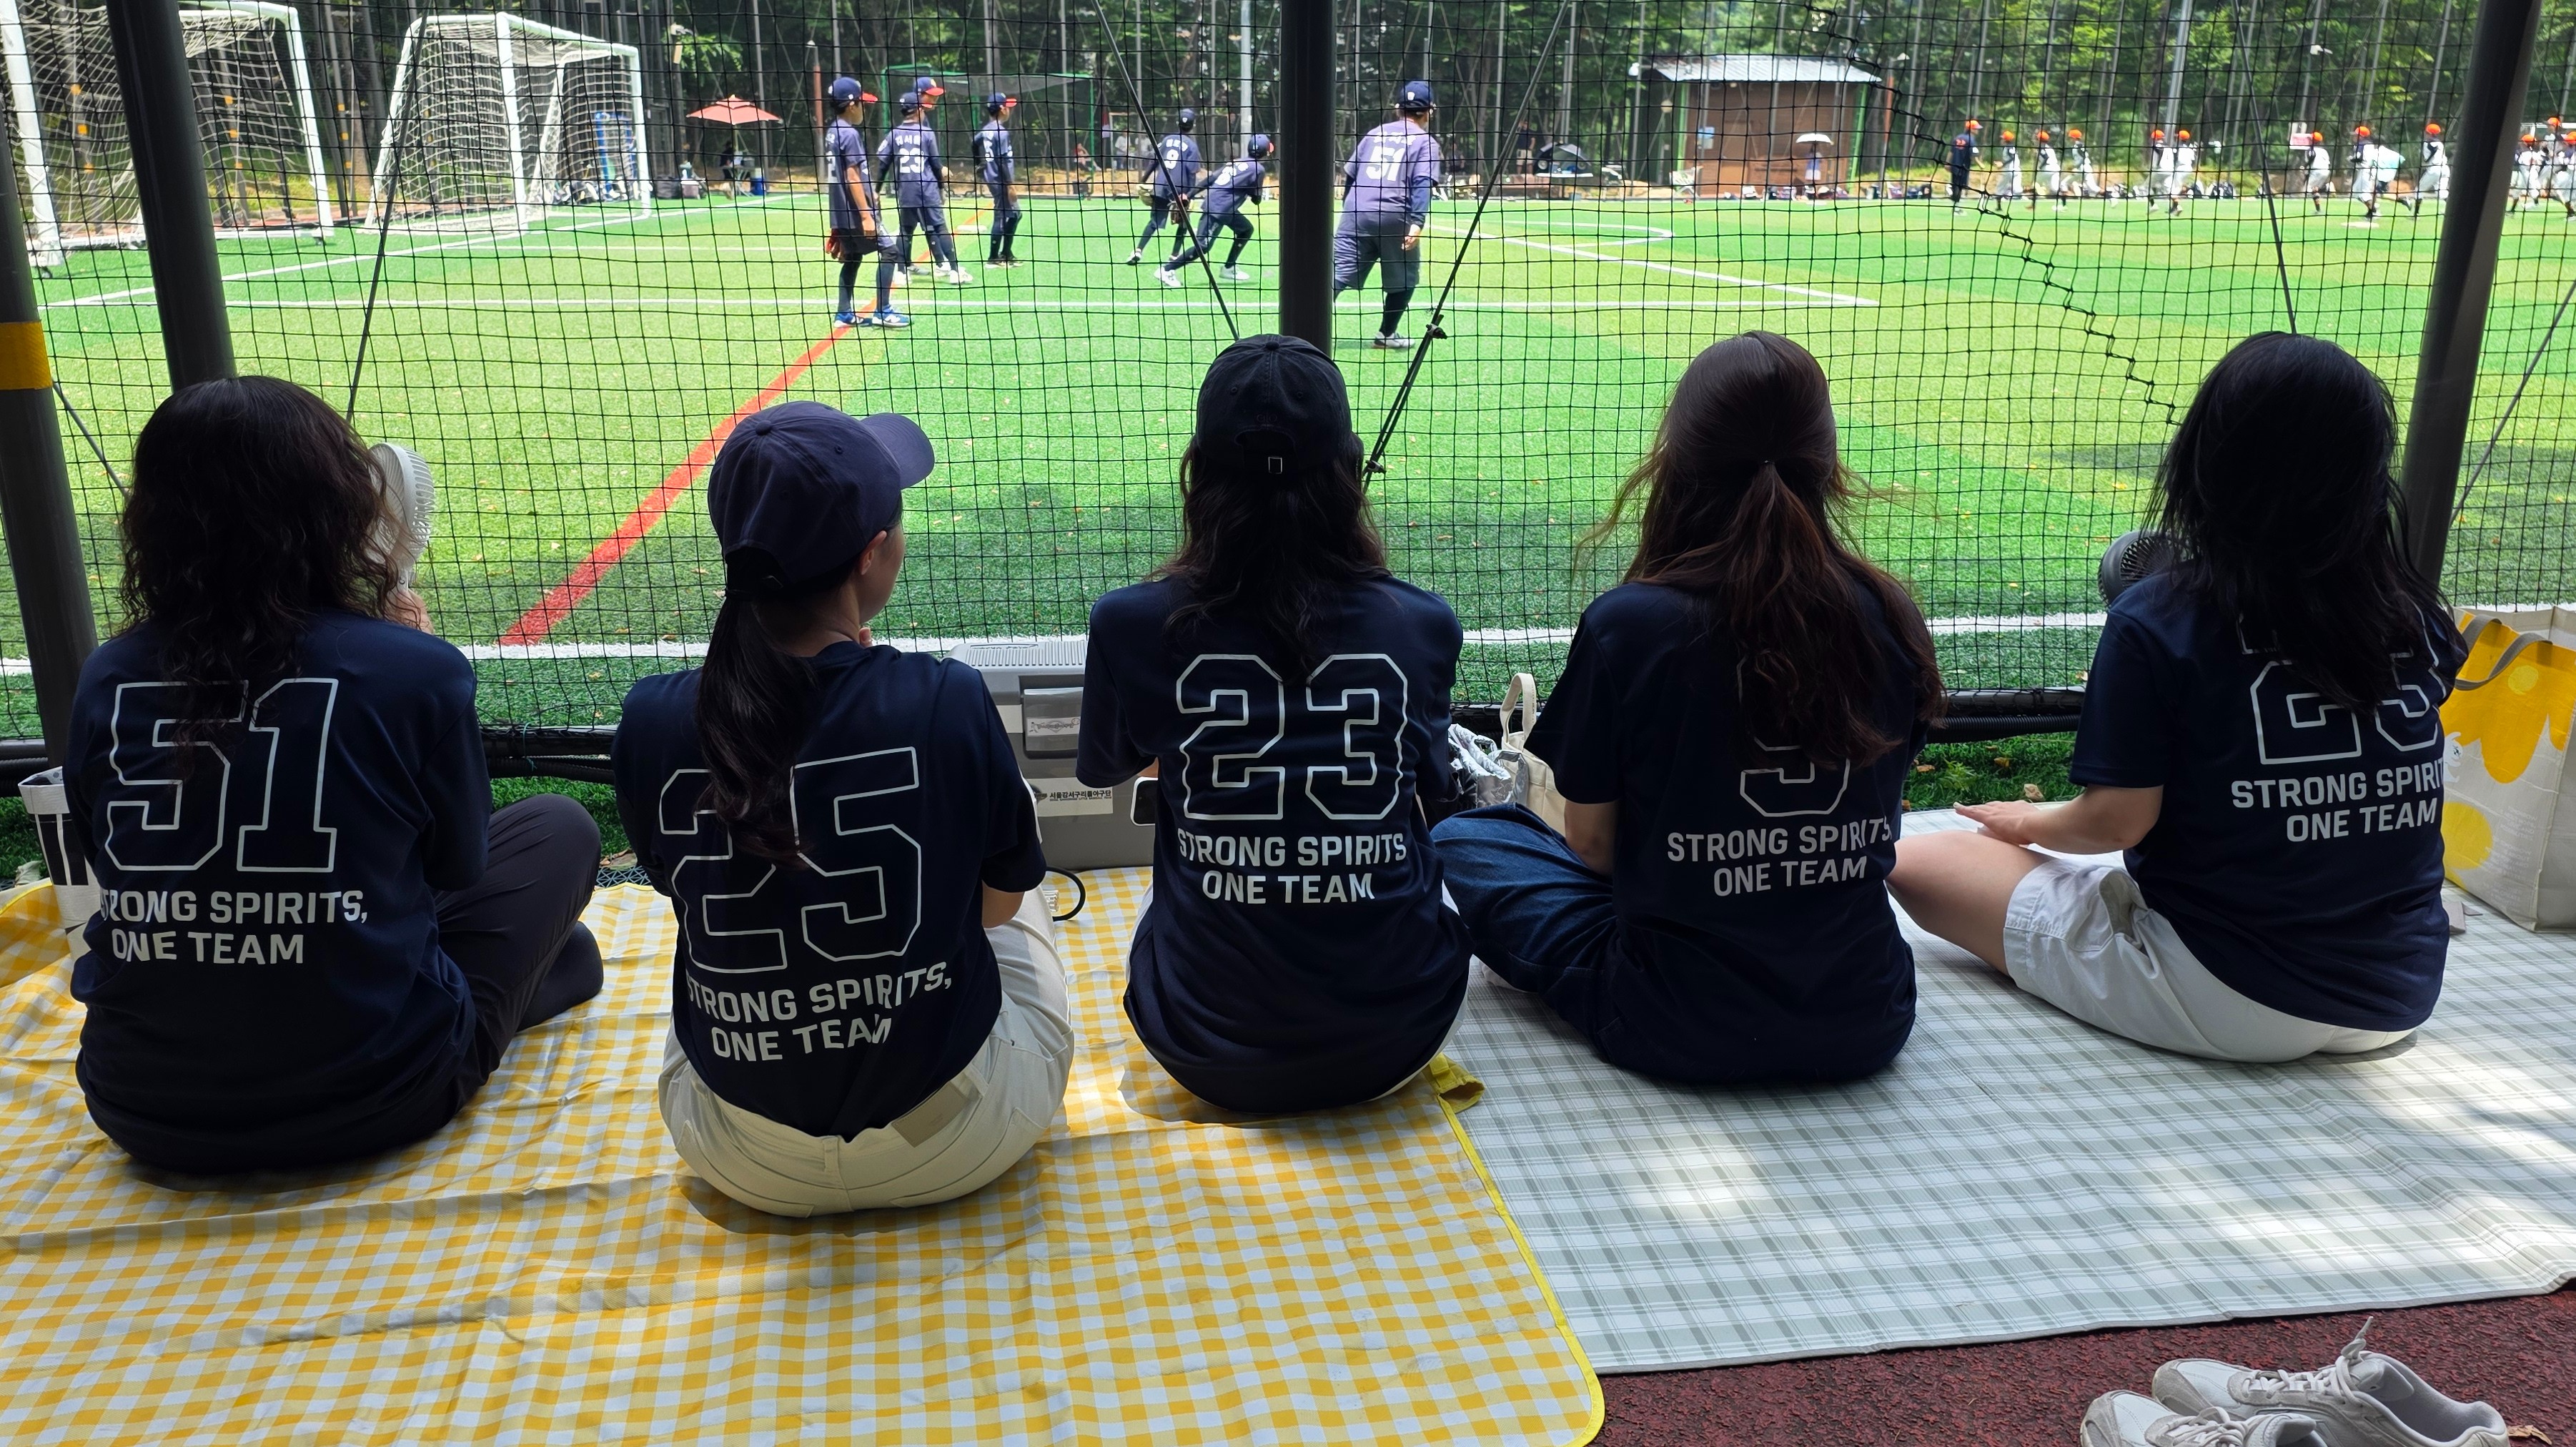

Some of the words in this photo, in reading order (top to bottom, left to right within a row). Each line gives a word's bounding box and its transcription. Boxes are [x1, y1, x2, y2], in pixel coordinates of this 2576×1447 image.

[1366, 145, 1405, 182] 51
[1176, 653, 1408, 821] 23
[105, 678, 339, 872] 51
[2231, 771, 2367, 809] STRONG
[2287, 809, 2350, 843] ONE
[2359, 797, 2438, 834] TEAM
[658, 746, 922, 973] 25
[1177, 828, 1286, 867] STRONG
[1297, 833, 1407, 866] SPIRITS
[1667, 828, 1788, 862] STRONG
[1202, 870, 1267, 904] ONE
[1277, 873, 1375, 904] TEAM
[1714, 862, 1771, 897] ONE
[1780, 856, 1867, 887] TEAM
[210, 890, 367, 924] SPIRITS,
[112, 929, 177, 962] ONE
[188, 932, 304, 964] TEAM
[808, 962, 952, 1014] SPIRITS,
[711, 1027, 783, 1062] ONE
